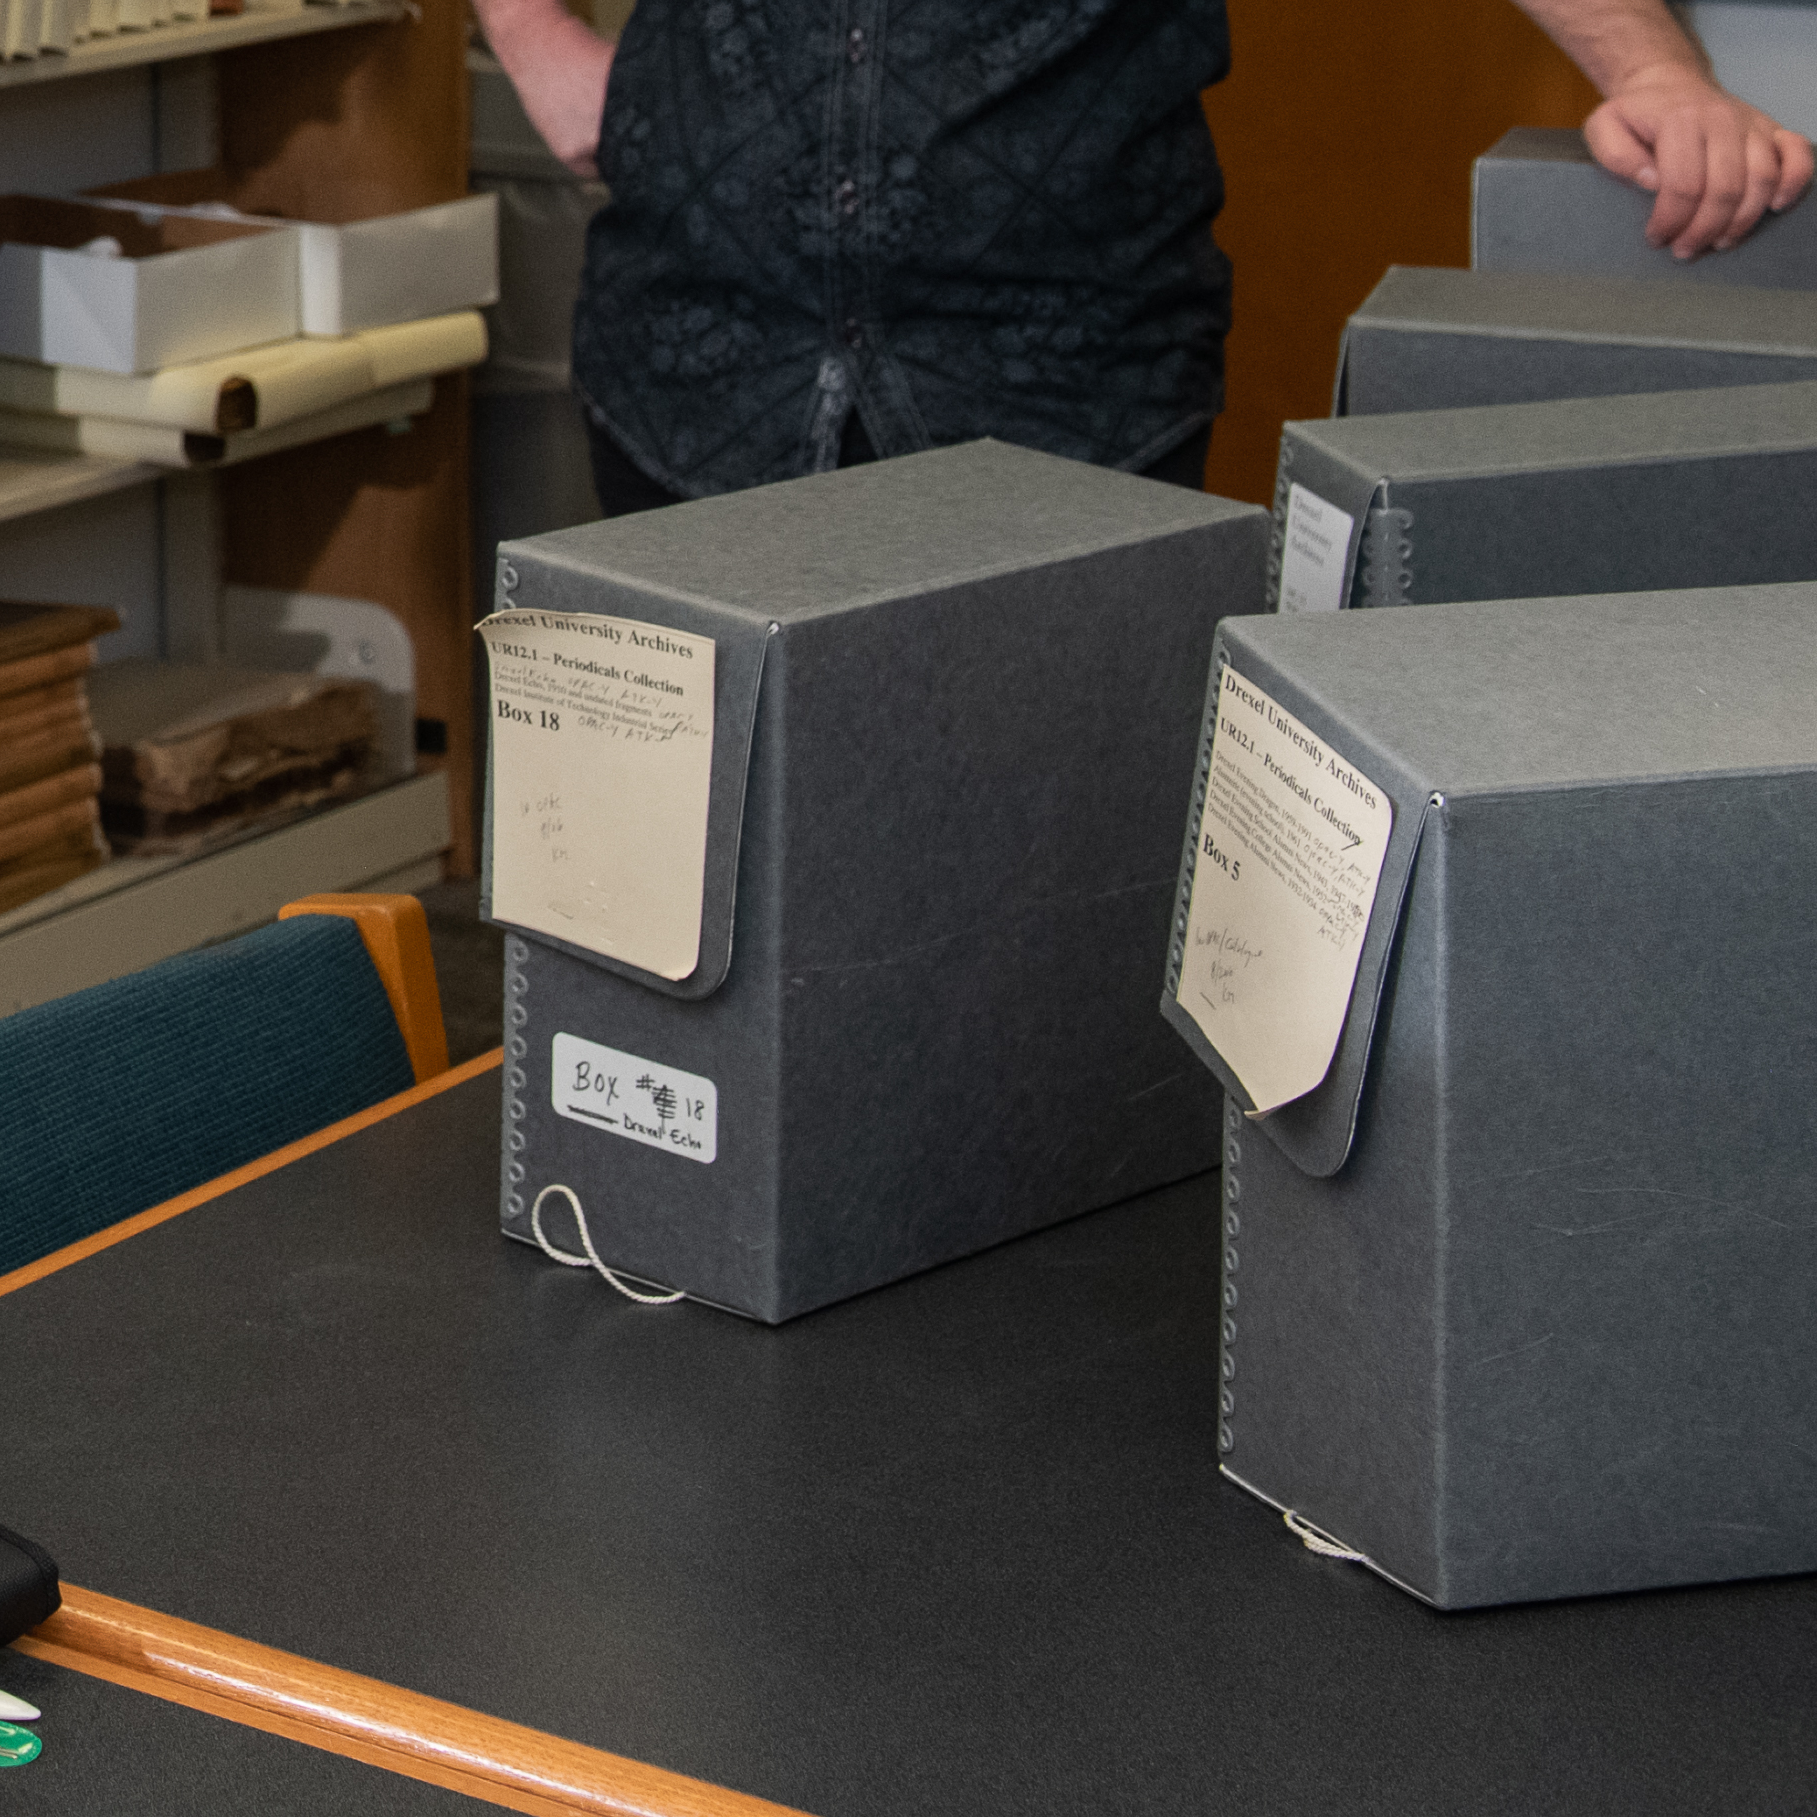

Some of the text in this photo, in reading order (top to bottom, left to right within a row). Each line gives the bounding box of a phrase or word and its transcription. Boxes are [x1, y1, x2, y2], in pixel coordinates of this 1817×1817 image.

[541, 616, 623, 645] University
[628, 630, 693, 659] Archives
[492, 642, 537, 661] UR12.1
[553, 653, 621, 680] Periodicals
[623, 670, 684, 696] Collection
[497, 699, 561, 731] Box 18
[567, 698, 611, 720] Technology
[1225, 674, 1377, 810] Drexel University Archives
[1216, 750, 1235, 773] Drexel
[1235, 766, 1258, 795] Evening
[1220, 717, 1255, 754] UR12.1
[1264, 752, 1312, 805] Periodicals
[1314, 796, 1363, 846] Collection
[1207, 801, 1226, 825] Drexel
[1226, 819, 1249, 848] Evening
[1209, 788, 1229, 811] Drexel
[1250, 826, 1272, 854] College
[1211, 776, 1230, 799] Drexel
[1230, 792, 1253, 822] Evening
[1253, 813, 1272, 837] School
[1203, 833, 1241, 881] Box 5
[623, 1113, 703, 1150] Drexel Echo
[686, 1097, 706, 1120] 18
